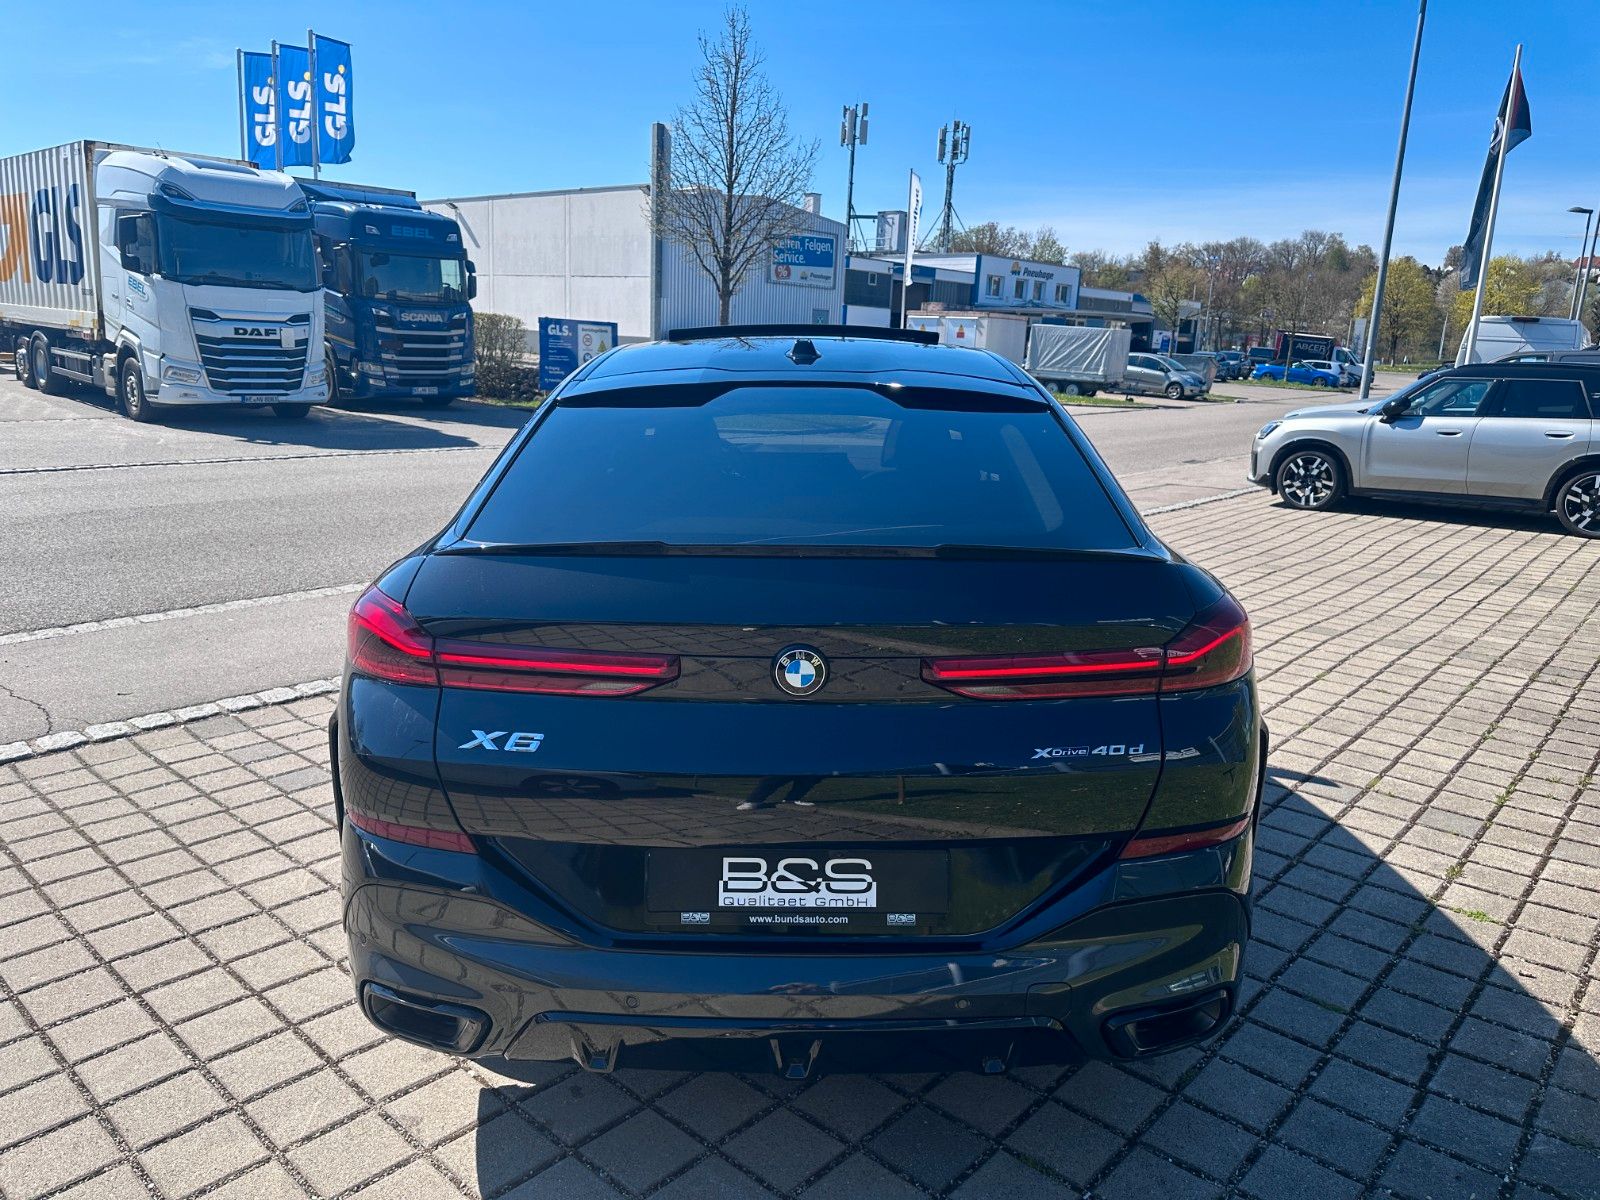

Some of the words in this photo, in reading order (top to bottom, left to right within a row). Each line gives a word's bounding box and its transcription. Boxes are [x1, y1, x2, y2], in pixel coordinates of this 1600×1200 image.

[32, 183, 84, 285] GLS
[391, 225, 434, 239] EBEL
[804, 239, 833, 254] Felgen,
[773, 250, 806, 263] Service.
[1022, 267, 1055, 280] Pneuhage
[401, 312, 443, 323] SCANIA
[233, 327, 277, 336] DAF
[780, 651, 821, 667] BMW
[458, 729, 545, 752] X6
[722, 857, 873, 894] B&S
[723, 895, 807, 907] Qualitaet
[749, 914, 848, 925] www.bundsauto.com
